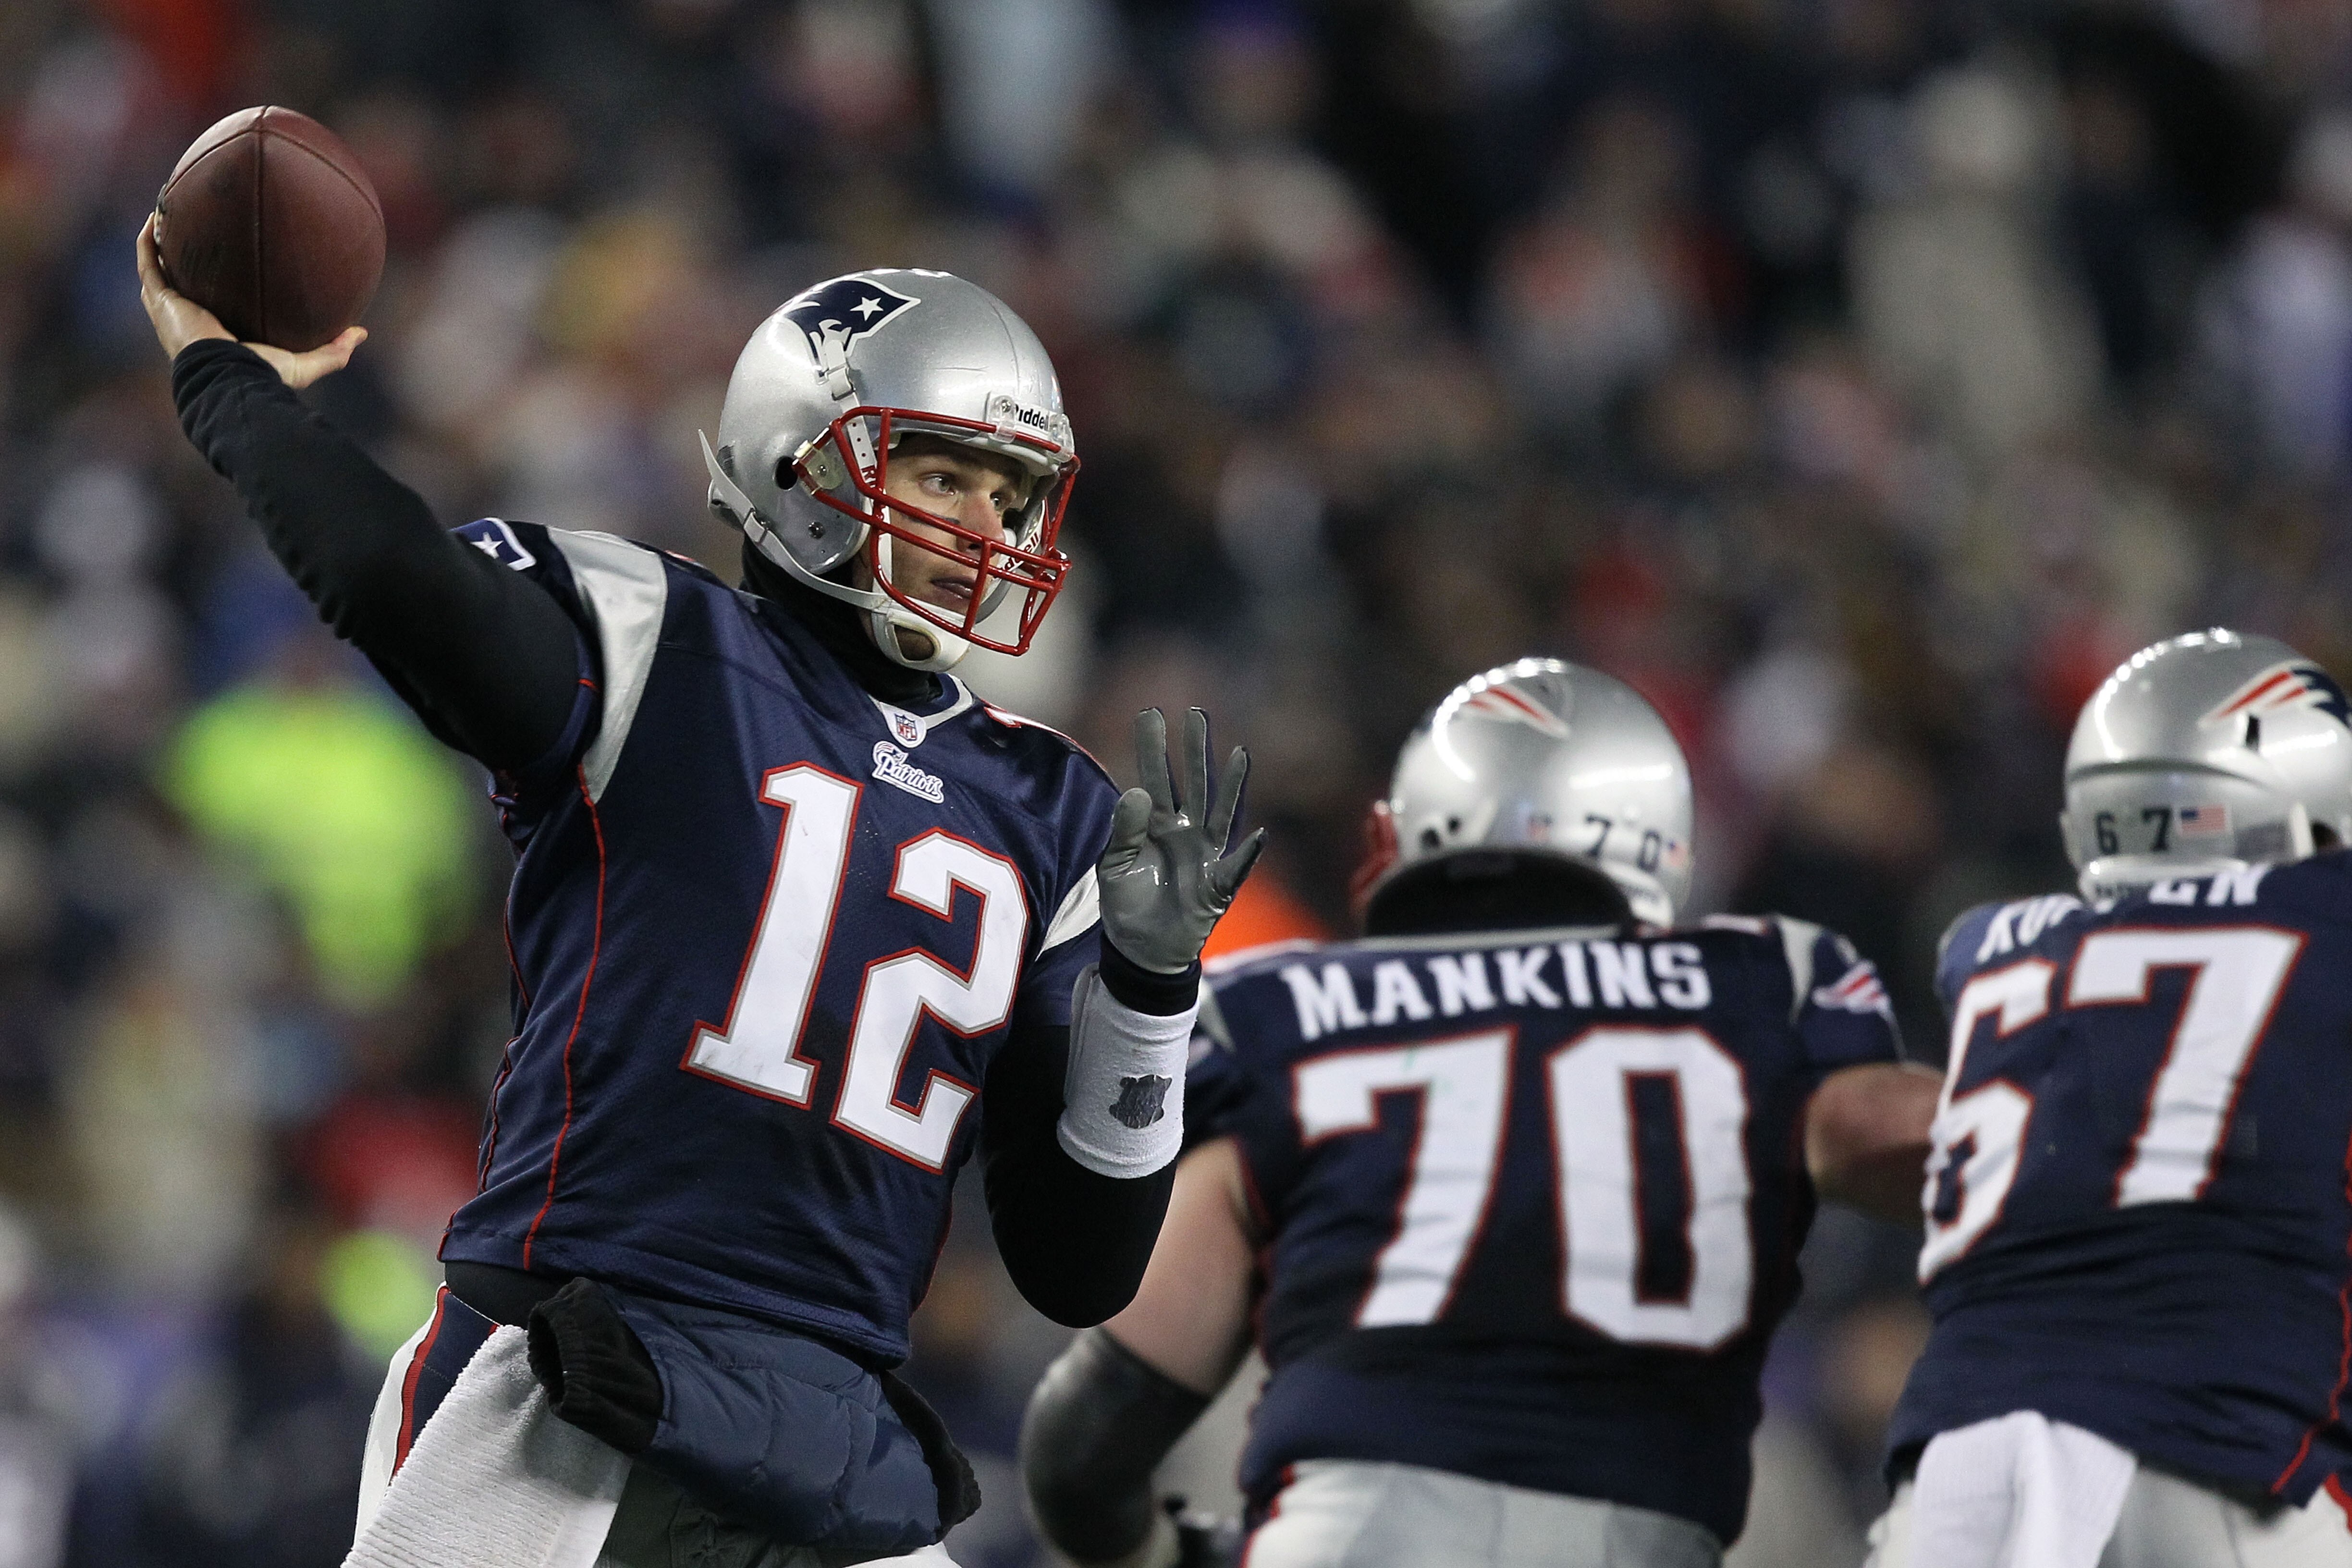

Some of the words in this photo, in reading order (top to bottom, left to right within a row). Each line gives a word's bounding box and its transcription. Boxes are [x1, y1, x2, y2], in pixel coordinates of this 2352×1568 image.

[898, 723, 917, 739] NFL
[876, 751, 943, 797] Patriots
[1584, 813, 1662, 873] 70
[2093, 807, 2173, 856] 67
[680, 760, 1029, 1176] 12
[1280, 941, 1712, 1041] MANKINS
[1918, 922, 2310, 1286] 67
[1291, 1023, 1756, 1352] 70
